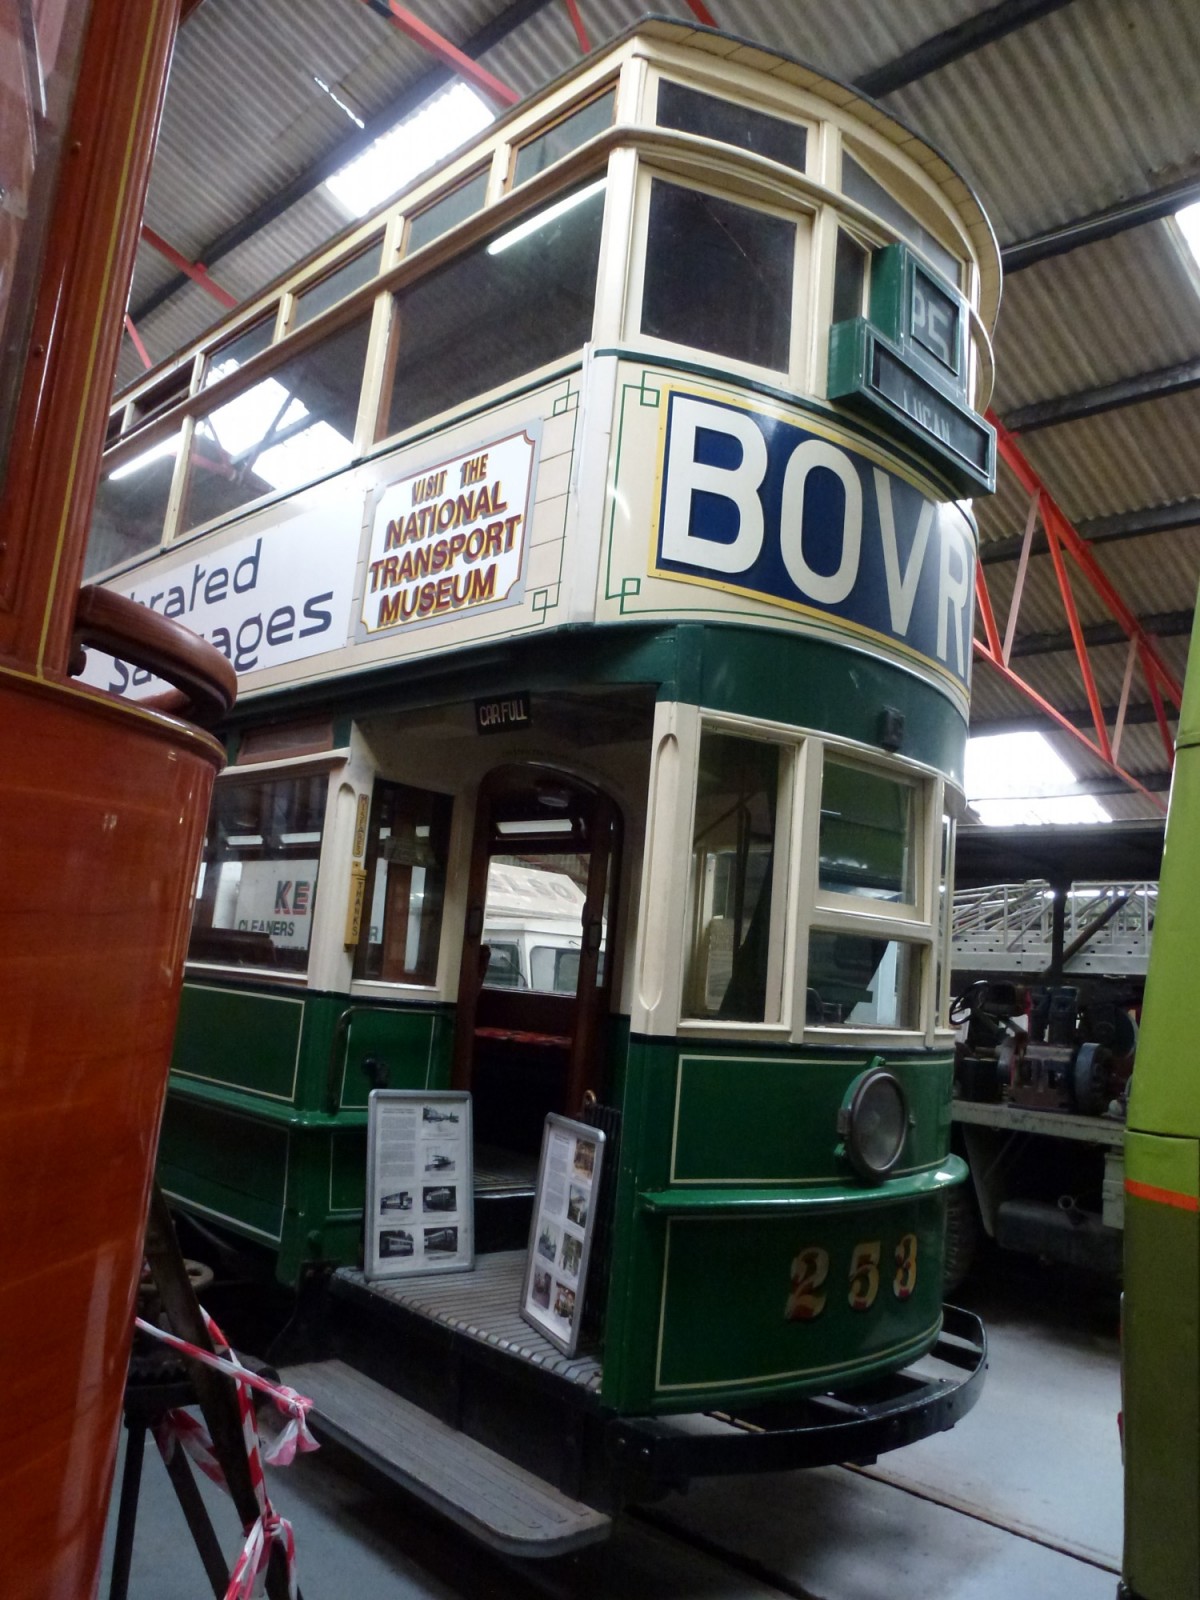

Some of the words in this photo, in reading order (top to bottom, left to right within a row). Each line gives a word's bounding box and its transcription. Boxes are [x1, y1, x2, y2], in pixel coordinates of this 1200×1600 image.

[412, 470, 448, 507] VISIT
[460, 454, 489, 488] THE
[384, 481, 509, 553] NATIONAL
[369, 514, 523, 593] TRANSPORT
[377, 564, 499, 628] MUSEUM
[480, 703, 500, 726] CAR
[501, 699, 528, 723] FULL
[274, 880, 317, 916] KE
[352, 881, 364, 937] THANKS
[239, 919, 295, 937] CLEANERS
[784, 1233, 918, 1320] 253
